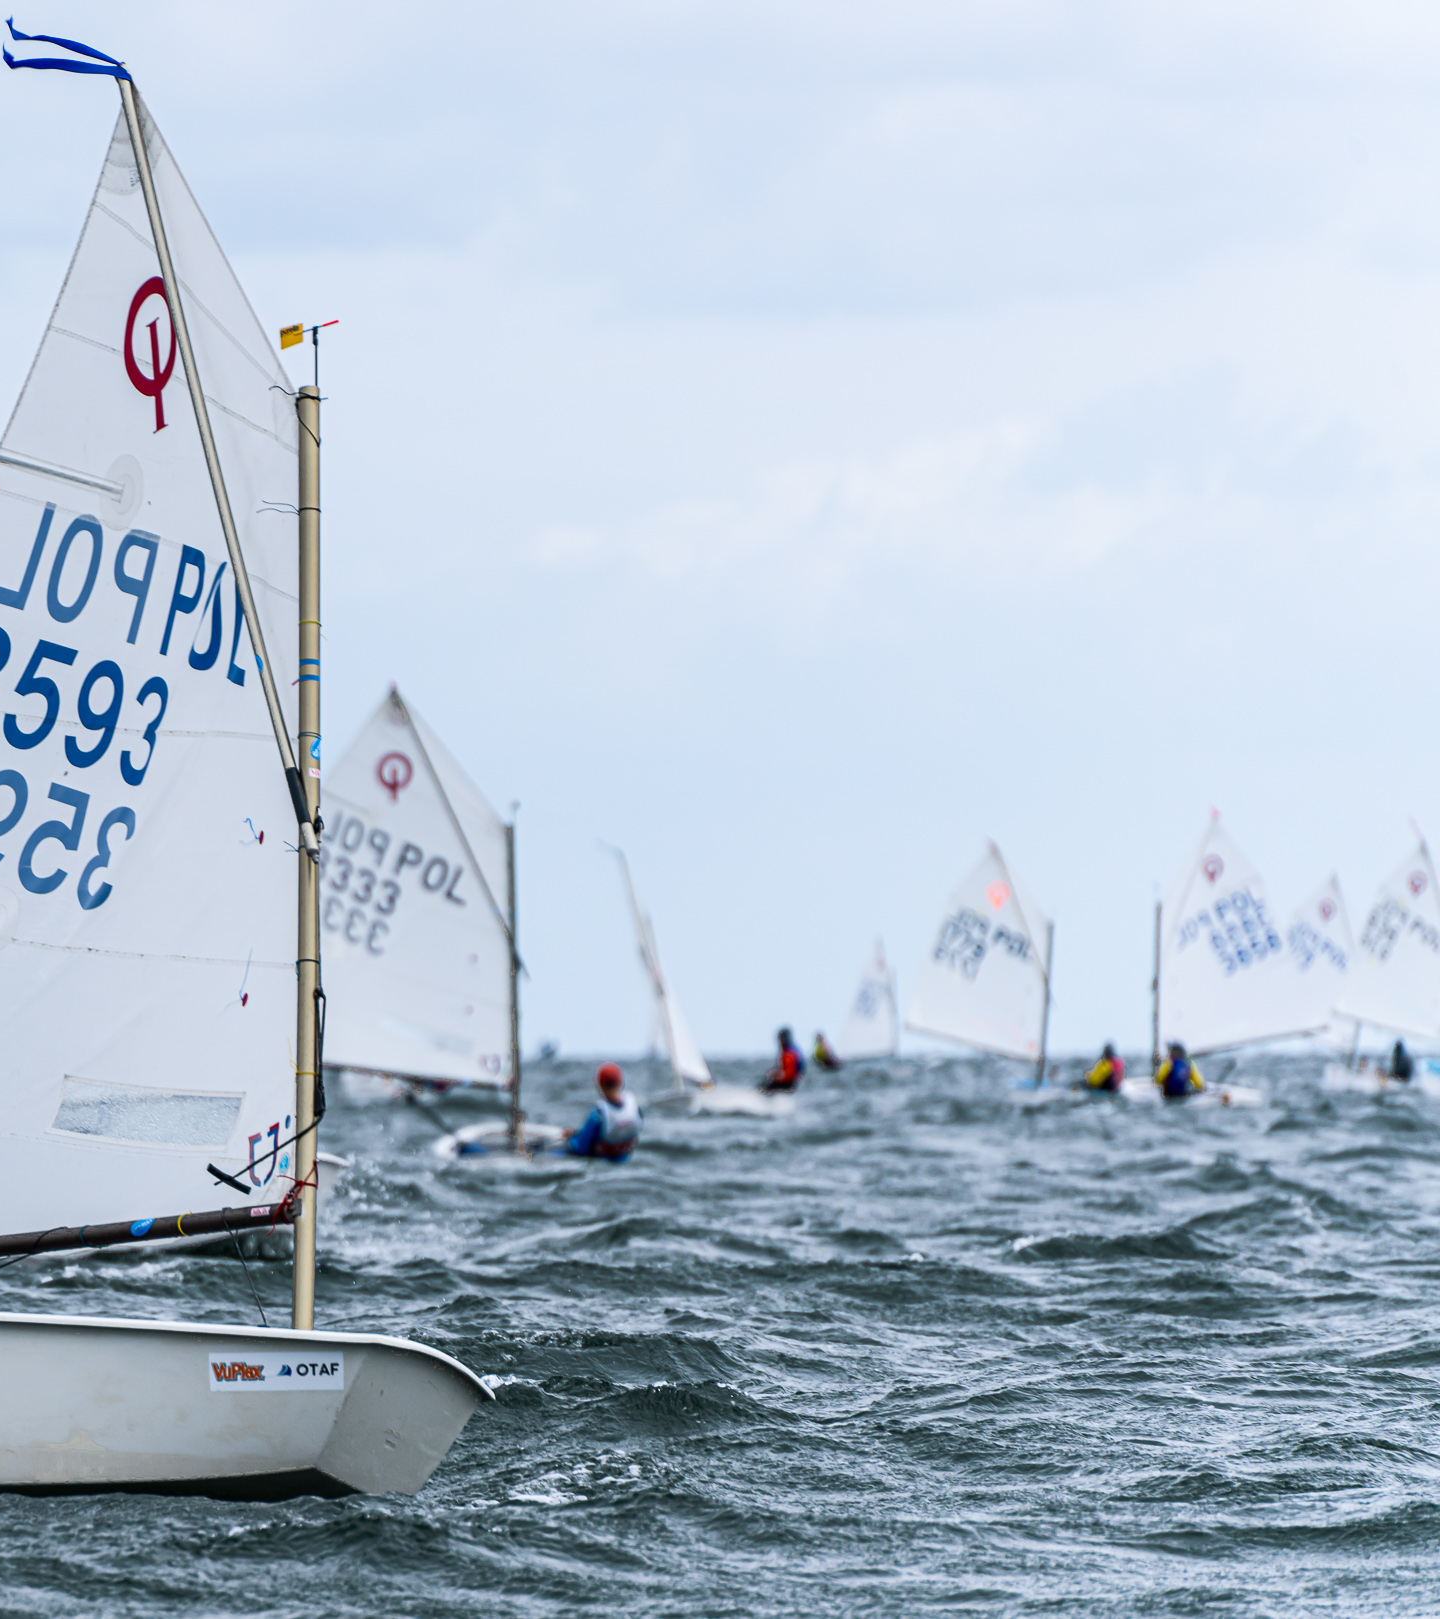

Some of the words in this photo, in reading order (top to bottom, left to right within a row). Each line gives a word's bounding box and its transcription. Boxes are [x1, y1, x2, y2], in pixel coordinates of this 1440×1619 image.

[160, 544, 246, 687] POL
[394, 841, 468, 908] POL
[211, 1362, 265, 1381] VuPlex
[296, 1363, 339, 1376] OTAF
